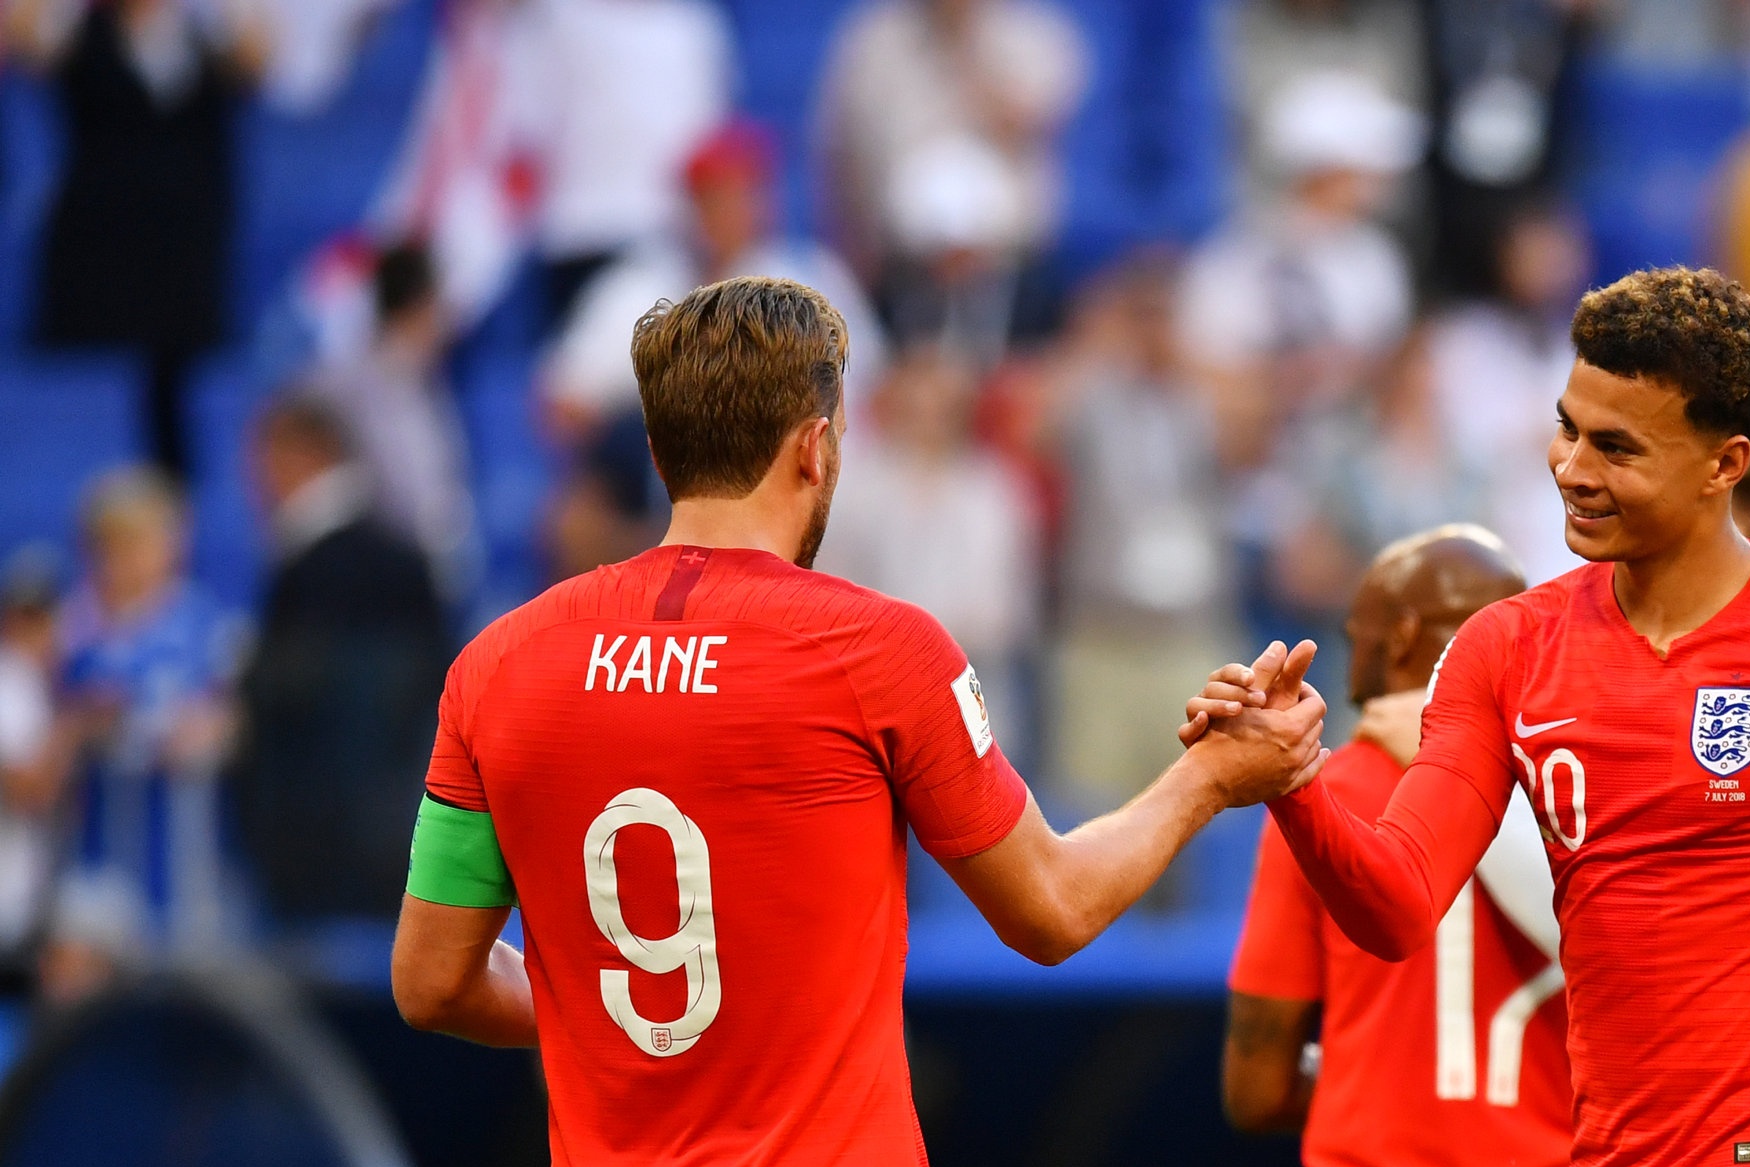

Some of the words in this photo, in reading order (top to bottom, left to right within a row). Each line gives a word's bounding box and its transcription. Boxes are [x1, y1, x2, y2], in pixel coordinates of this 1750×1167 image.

[584, 633, 728, 694] KANE
[1704, 792, 1711, 802] 7
[1712, 792, 1728, 802] JULY
[1708, 779, 1739, 789] SWEDEN
[583, 787, 723, 1058] 9
